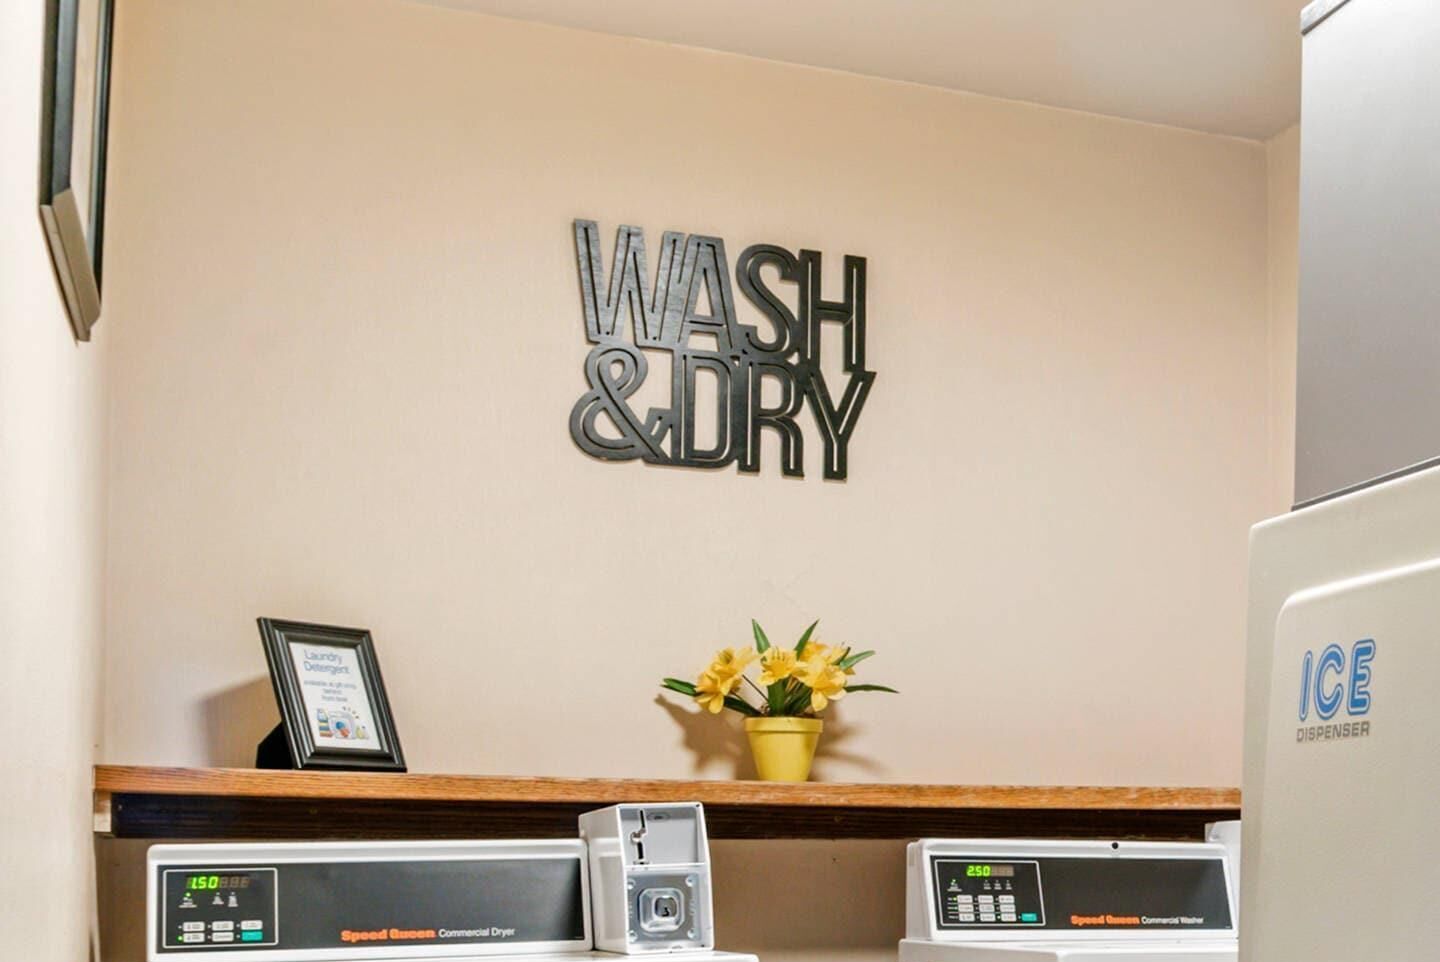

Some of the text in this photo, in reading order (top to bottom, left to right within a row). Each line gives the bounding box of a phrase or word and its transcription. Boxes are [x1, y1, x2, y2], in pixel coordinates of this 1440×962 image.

[572, 218, 867, 373] WASH
[568, 343, 878, 483] & DRY
[303, 649, 343, 664] Laundry
[303, 661, 351, 675] Detergent
[1299, 639, 1376, 722] ICE
[1296, 721, 1371, 743] DISPENSER
[1071, 915, 1105, 927] Speed
[1106, 914, 1140, 925] Queen
[1141, 915, 1180, 925] Commercial
[341, 926, 516, 943] Speed Queen Commercial Dryer
